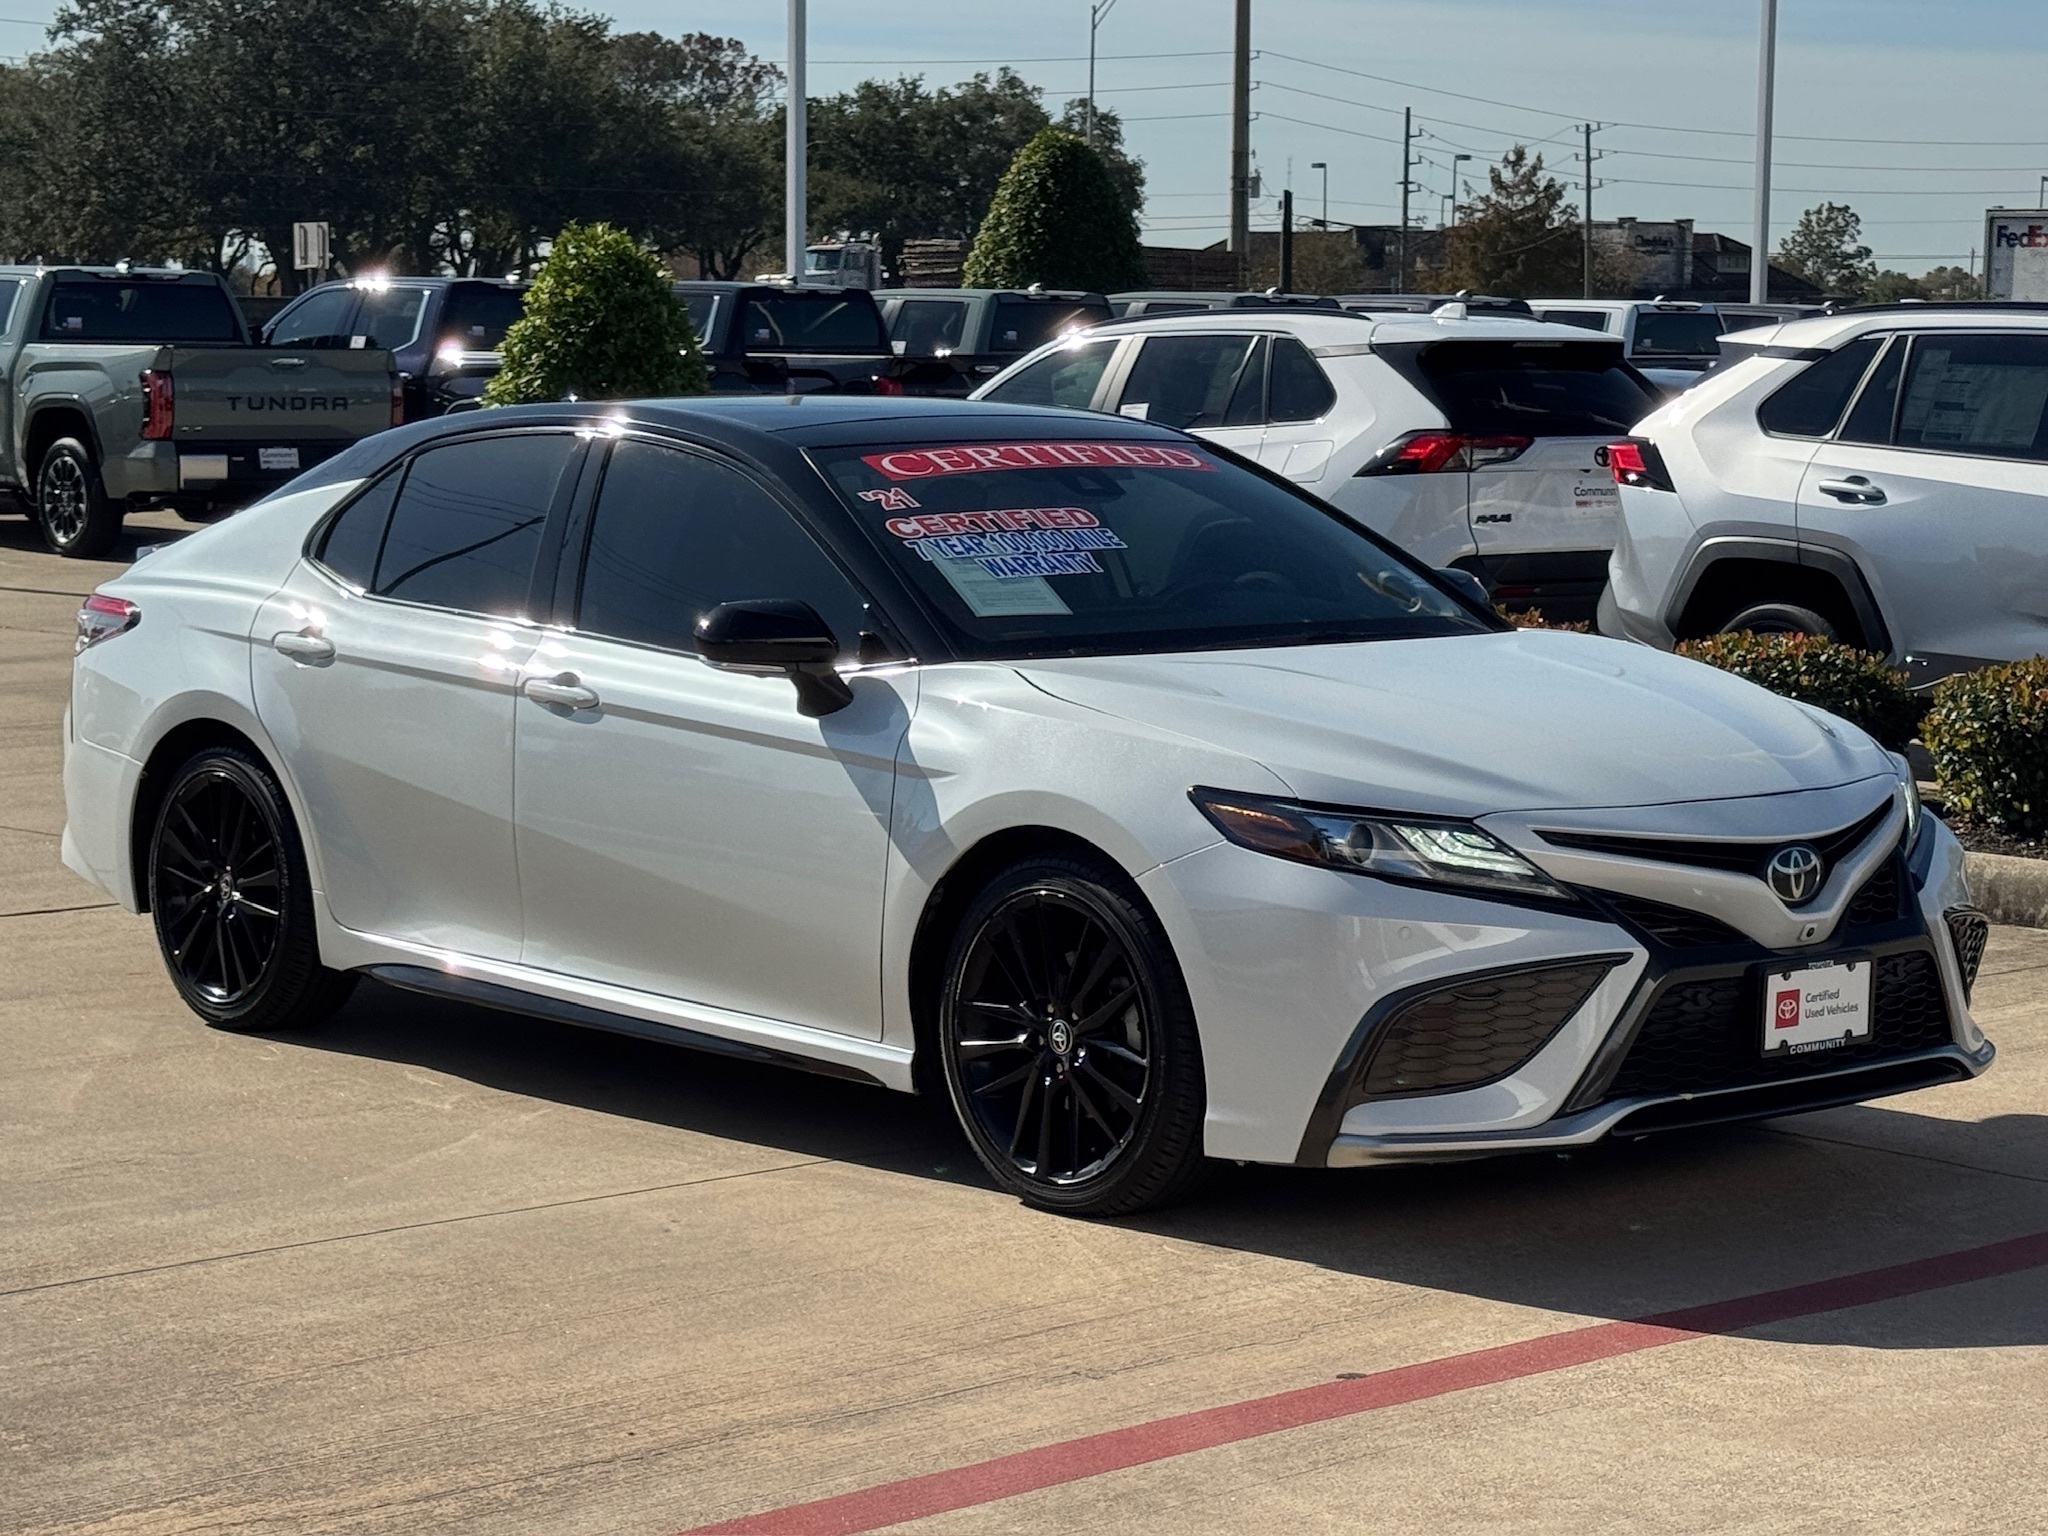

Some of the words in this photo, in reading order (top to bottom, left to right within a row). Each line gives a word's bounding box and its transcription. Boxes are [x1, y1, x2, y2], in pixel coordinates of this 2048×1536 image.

[226, 396, 348, 411] TUNDRA
[880, 444, 1201, 476] CERTIFIED
[885, 507, 1100, 538] CERTIFIED
[903, 538, 932, 562] 7
[924, 535, 992, 559] YEAR
[1064, 528, 1128, 551] MILE
[975, 552, 1104, 579] WARRANTY
[1805, 988, 1840, 1003] Certified
[1804, 1005, 1825, 1019] Used
[1826, 1002, 1859, 1016] Vehicles
[1789, 1038, 1846, 1054] COMMUNITY
